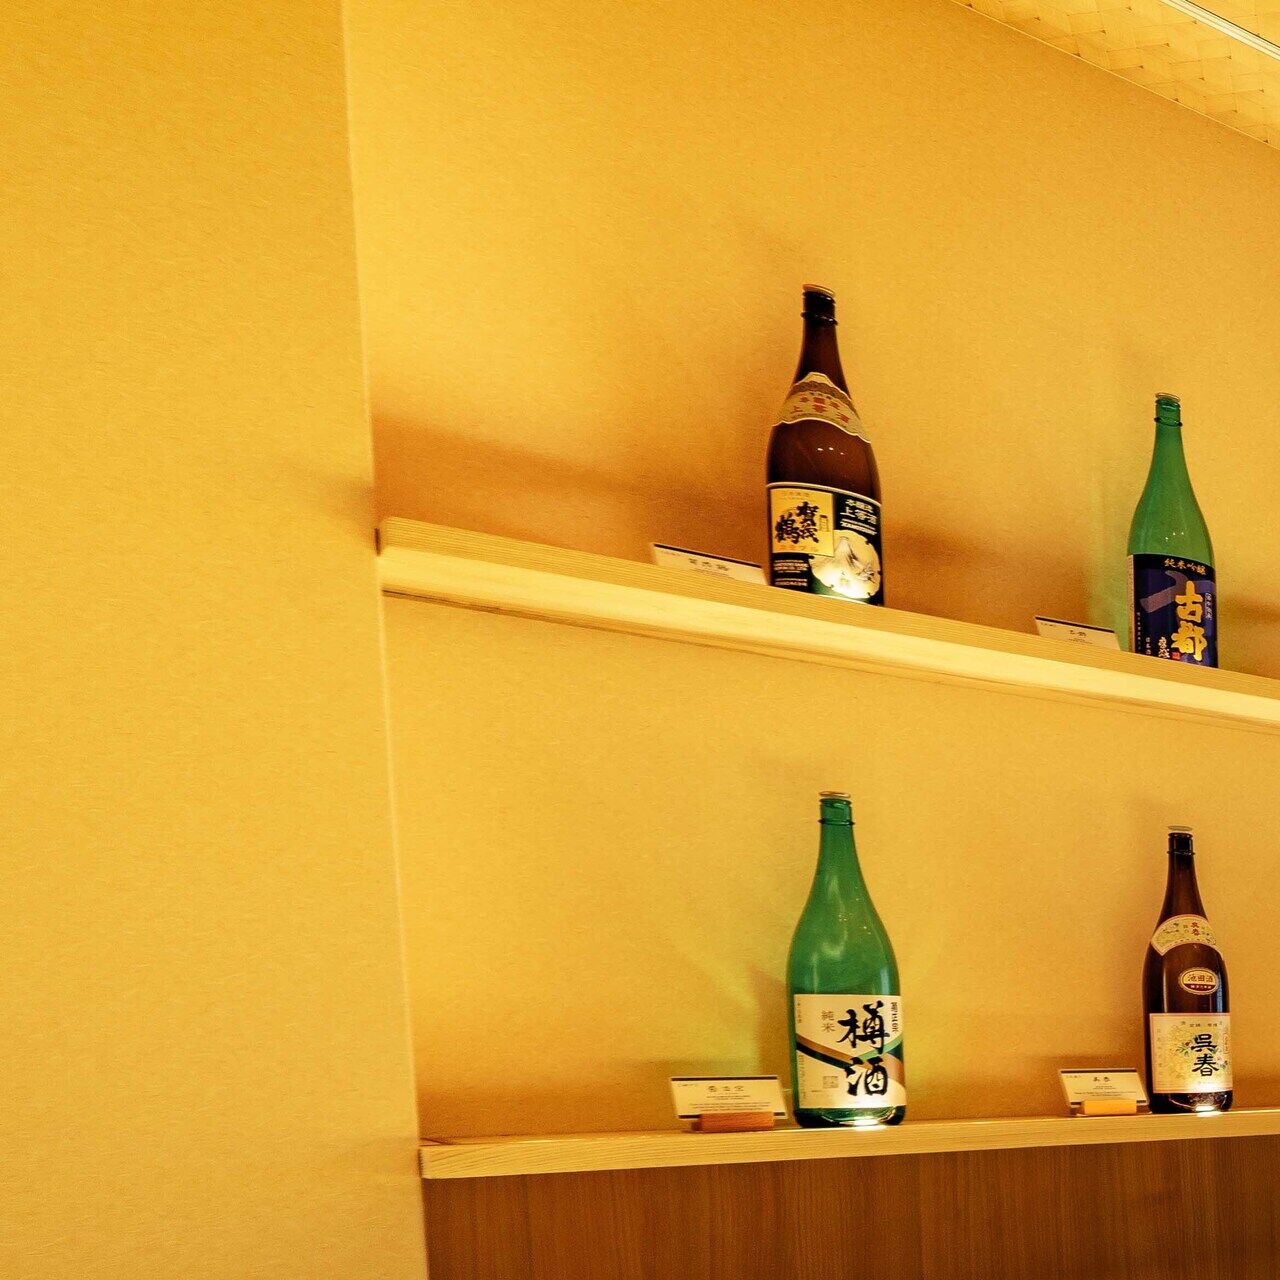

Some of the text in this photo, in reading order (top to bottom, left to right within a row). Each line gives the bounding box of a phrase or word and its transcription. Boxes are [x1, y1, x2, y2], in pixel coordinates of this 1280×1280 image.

[1171, 580, 1207, 661] 古都
[836, 1000, 890, 1096] 樽酒
[1190, 1033, 1219, 1077] 呉春
